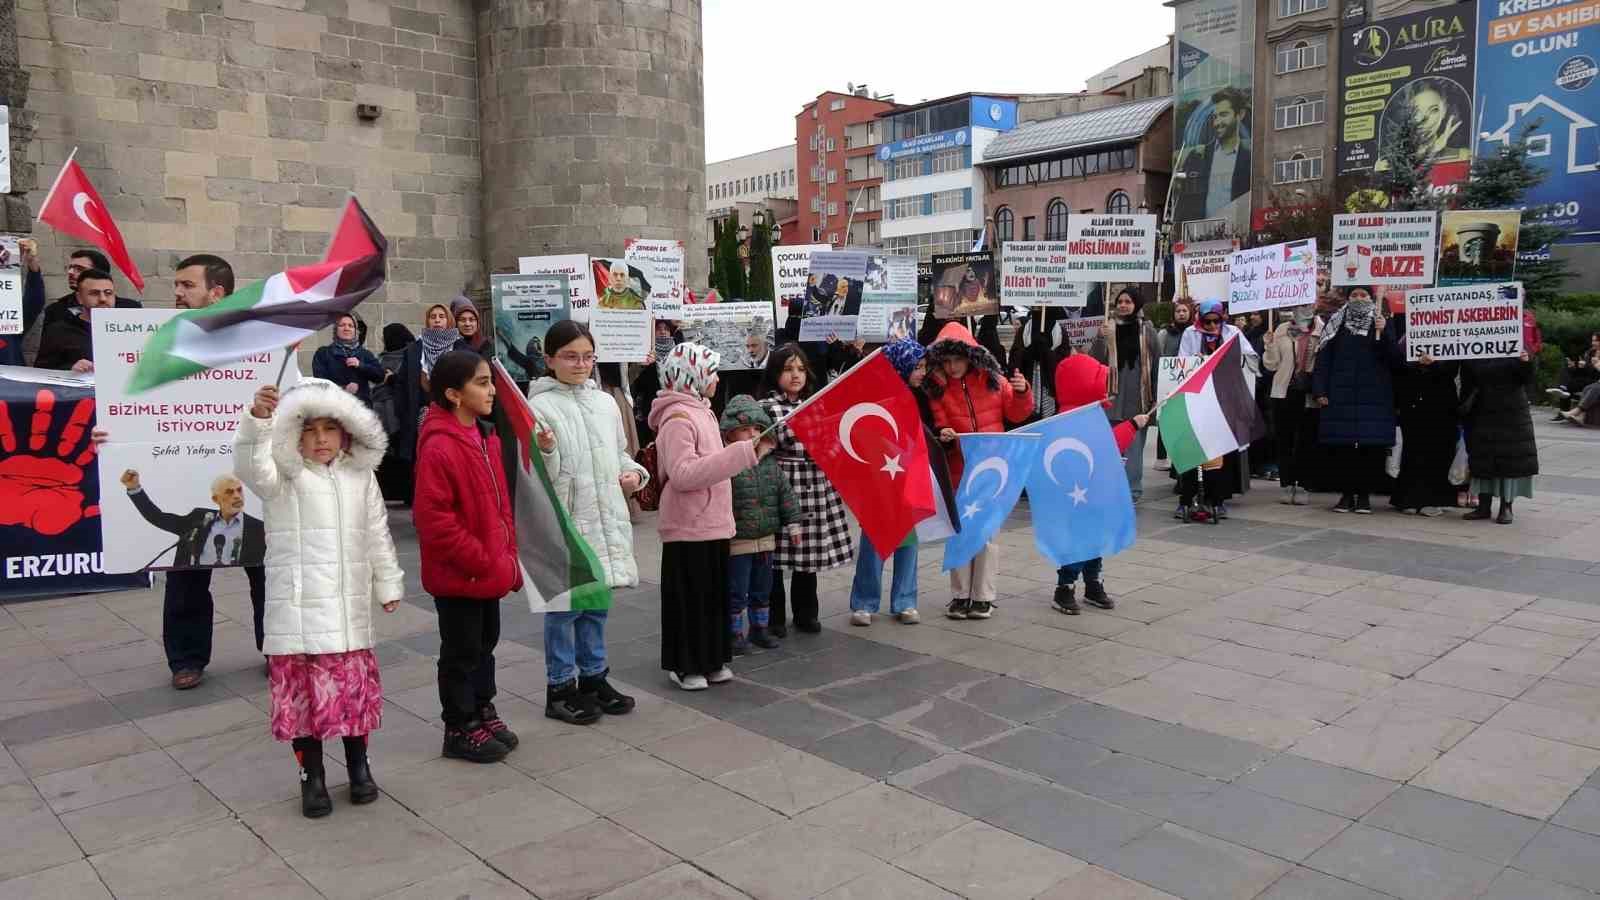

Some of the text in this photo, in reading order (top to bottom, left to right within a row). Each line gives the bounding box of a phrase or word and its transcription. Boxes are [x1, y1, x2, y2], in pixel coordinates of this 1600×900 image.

[1395, 15, 1465, 46] AURA
[1493, 20, 1521, 40] EV
[1511, 32, 1578, 58] OLUN!
[1068, 238, 1130, 255] MÜSLÜMAN
[777, 253, 810, 264] ÇOCUKL
[778, 265, 809, 278] ÖLME
[1004, 274, 1046, 288] Allah'ın
[1409, 292, 1435, 305] ÇİFTE
[1409, 301, 1519, 327] SİYONİST ASKERLERİN
[105, 321, 143, 333] İSLAM
[1463, 325, 1520, 339] YAŞAMASINI
[1409, 338, 1519, 358] İSTEMİYORUZ
[108, 402, 244, 416] BİZİMLE KURTULM
[6, 551, 106, 579] ERZURU
